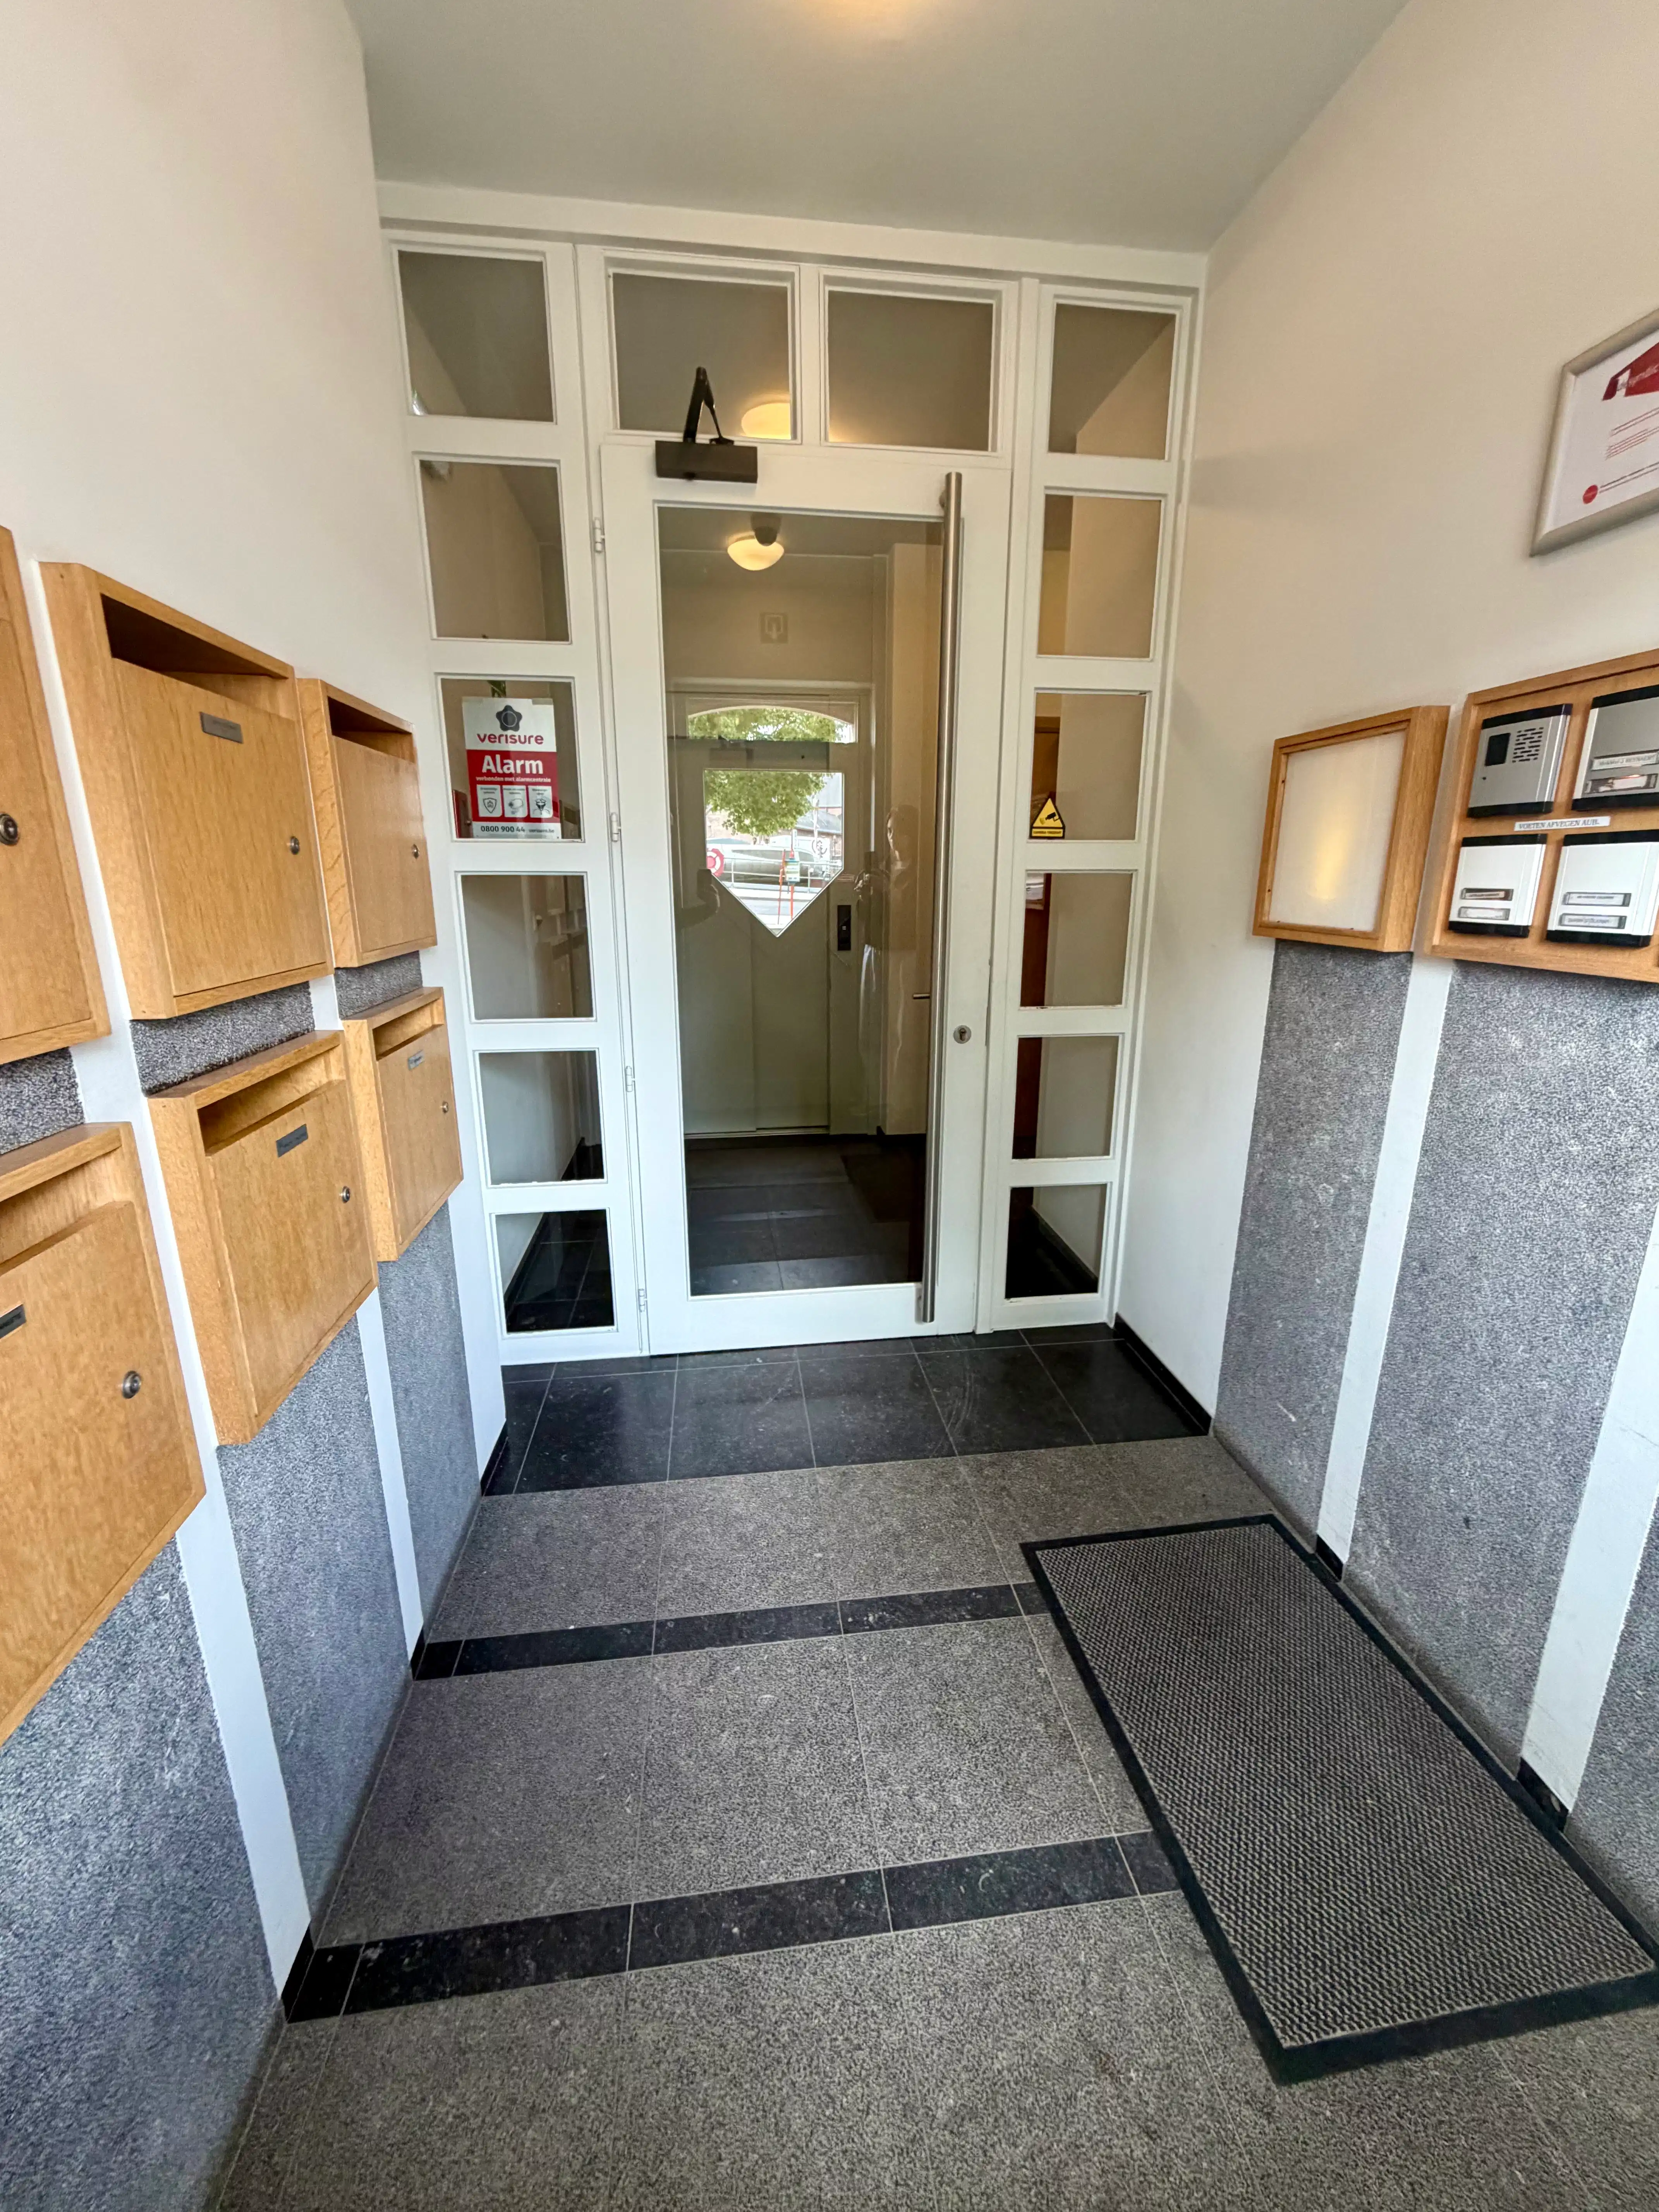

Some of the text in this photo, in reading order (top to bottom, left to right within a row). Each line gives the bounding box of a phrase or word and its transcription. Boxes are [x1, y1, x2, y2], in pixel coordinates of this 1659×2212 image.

[477, 733, 544, 745] verisure
[482, 754, 543, 774] Alarm
[1546, 820, 1580, 828] AFVEGEN
